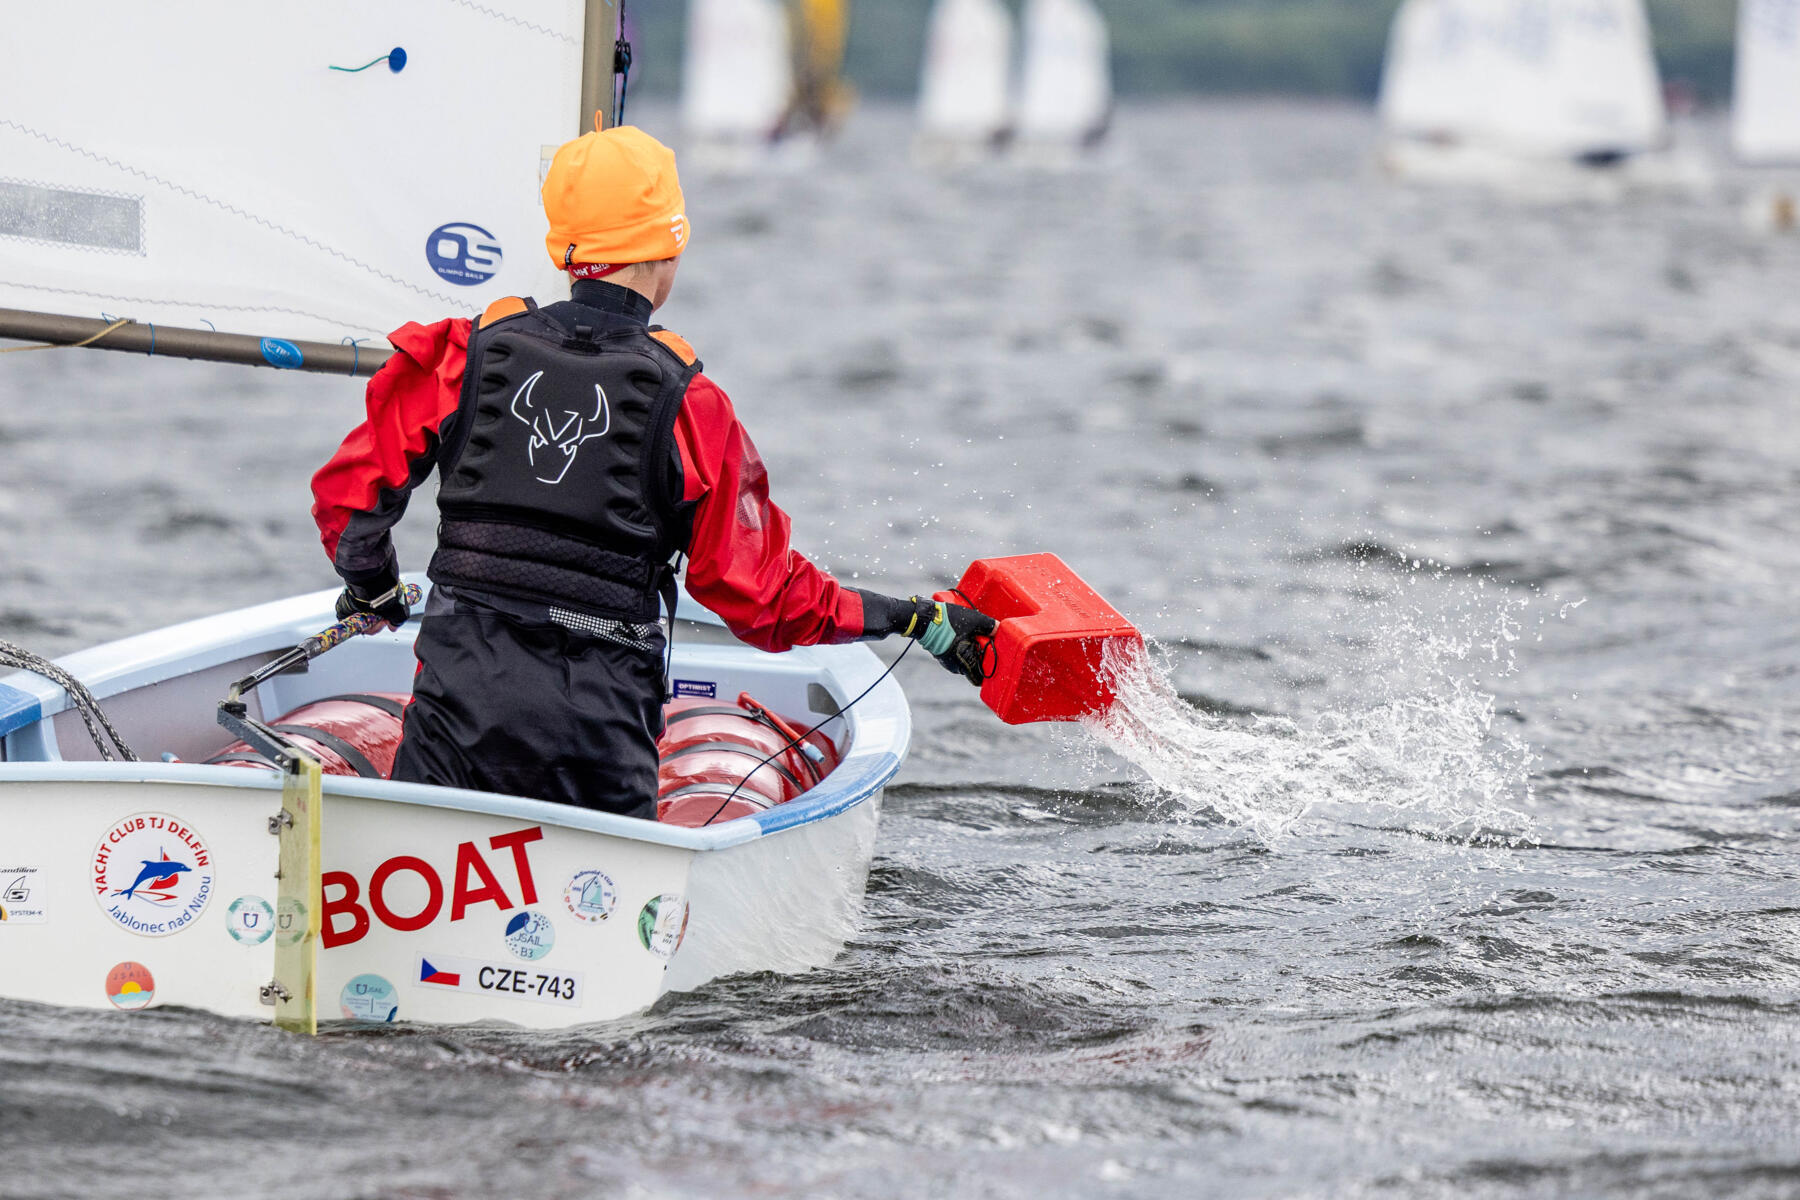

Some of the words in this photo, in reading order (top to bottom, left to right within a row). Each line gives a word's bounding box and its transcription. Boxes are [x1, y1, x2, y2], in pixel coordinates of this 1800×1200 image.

[94, 843, 112, 895] YACHT
[109, 817, 146, 844] CLUB
[149, 816, 165, 829] TJ
[107, 904, 166, 933] Jablonec
[168, 908, 193, 930] nad
[188, 876, 211, 913] Nisou
[321, 826, 543, 949] BOAT
[514, 933, 543, 947] JSAIL
[520, 947, 533, 958] B3
[478, 966, 575, 1000] CZE-743
